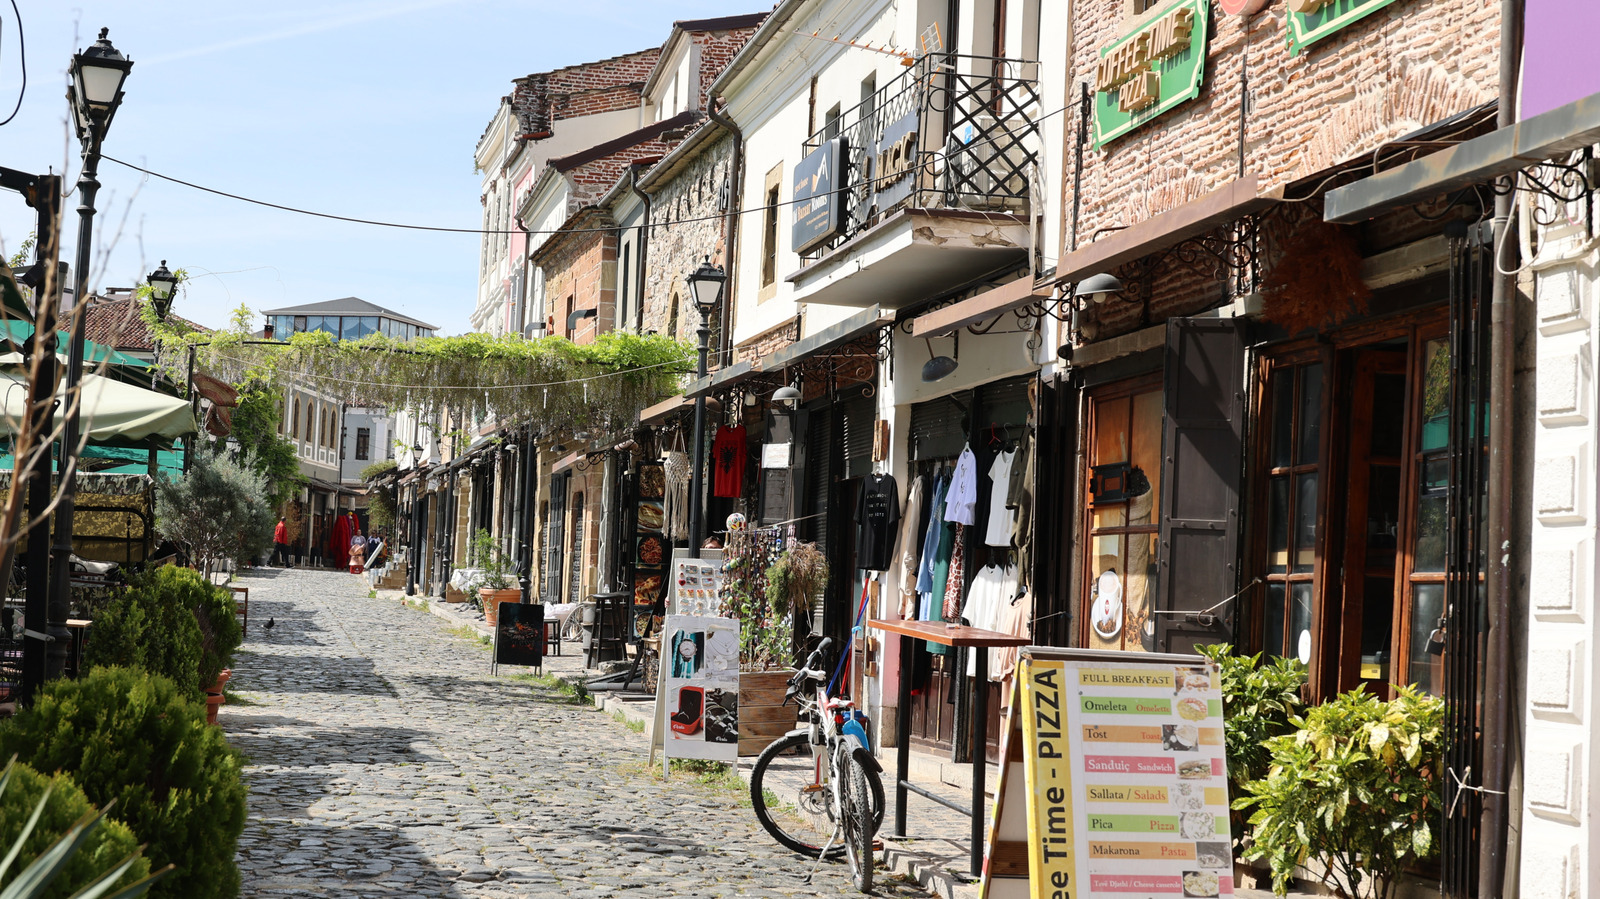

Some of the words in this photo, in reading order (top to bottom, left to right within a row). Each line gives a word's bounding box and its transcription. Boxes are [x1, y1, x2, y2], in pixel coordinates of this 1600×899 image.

[1095, 32, 1150, 91] COFFEE
[1147, 6, 1194, 61] TIME
[1118, 69, 1160, 112] PIZZA
[1082, 674, 1109, 683] FULL
[1112, 675, 1170, 684] BREAKFAST
[1084, 700, 1127, 712] Omeleta
[1034, 668, 1063, 758] PIZZA
[1085, 728, 1107, 739] Tost
[1141, 731, 1160, 740] Toast
[1088, 759, 1130, 772] Sanduiç
[1137, 763, 1173, 772] Sandwich
[1090, 788, 1124, 800] Sallata
[1134, 789, 1166, 801] Salads
[1042, 787, 1067, 864] Time
[1092, 818, 1113, 829] Pica
[1149, 819, 1175, 831] Pizza
[1092, 845, 1140, 856] Makarona
[1160, 845, 1187, 856] Pasta
